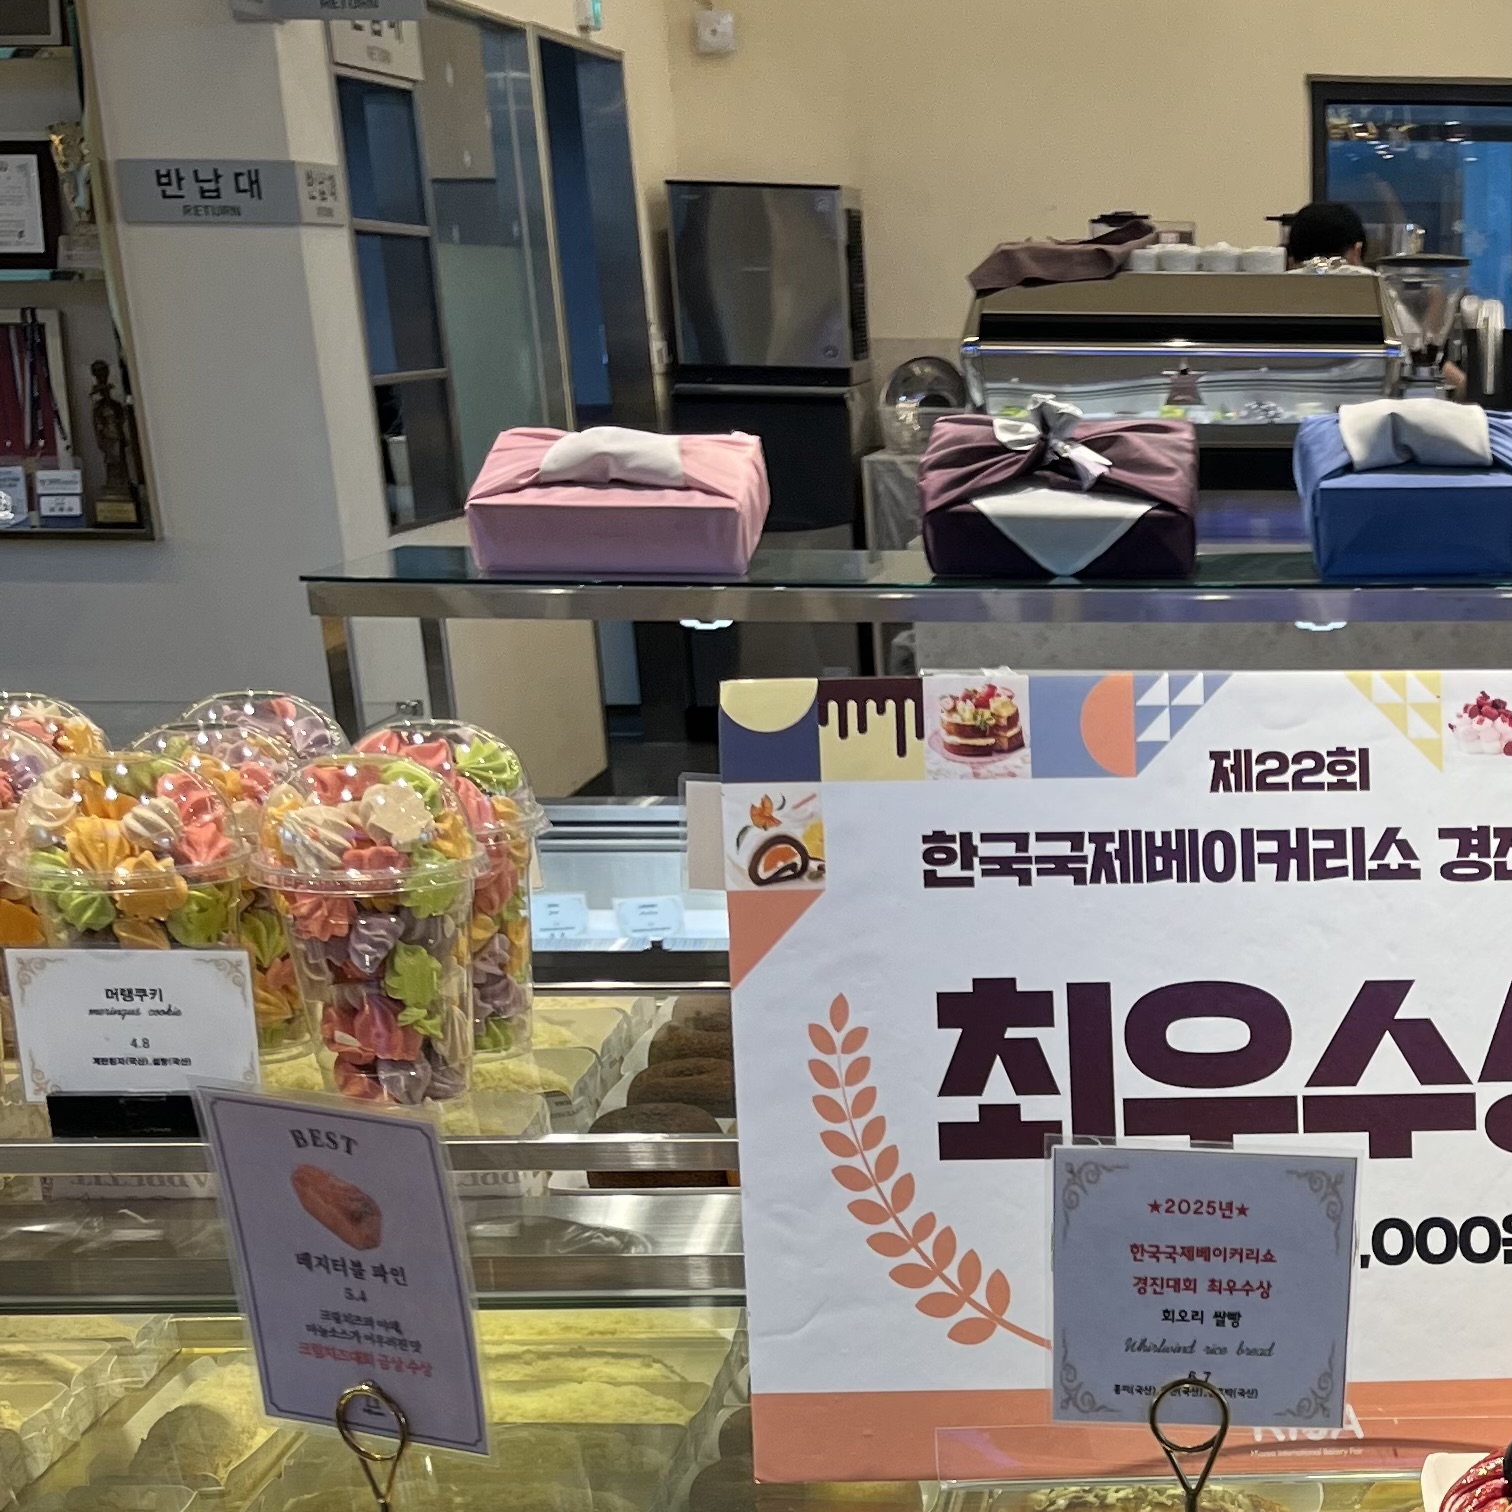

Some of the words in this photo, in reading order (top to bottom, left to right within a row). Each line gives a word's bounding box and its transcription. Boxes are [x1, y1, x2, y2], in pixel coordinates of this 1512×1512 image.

[155, 168, 262, 200] 반납대
[1209, 746, 1371, 794] 제22회
[921, 827, 1422, 889] 한국국제베이커리쇼
[105, 987, 164, 1002] 머랭쿠키
[130, 1037, 151, 1050] 4.8
[289, 1127, 359, 1156] BEST
[1129, 1243, 1278, 1264] 한국국제베이커리쇼
[1132, 1275, 1198, 1296] 경진대회
[1207, 1277, 1273, 1300] 최우수상
[1161, 1308, 1205, 1325] 회오리
[1213, 1310, 1242, 1328] 쌀빵
[1124, 1336, 1198, 1353] Whirlwind
[1236, 1341, 1276, 1357] bread
[1188, 1370, 1212, 1383] 67
